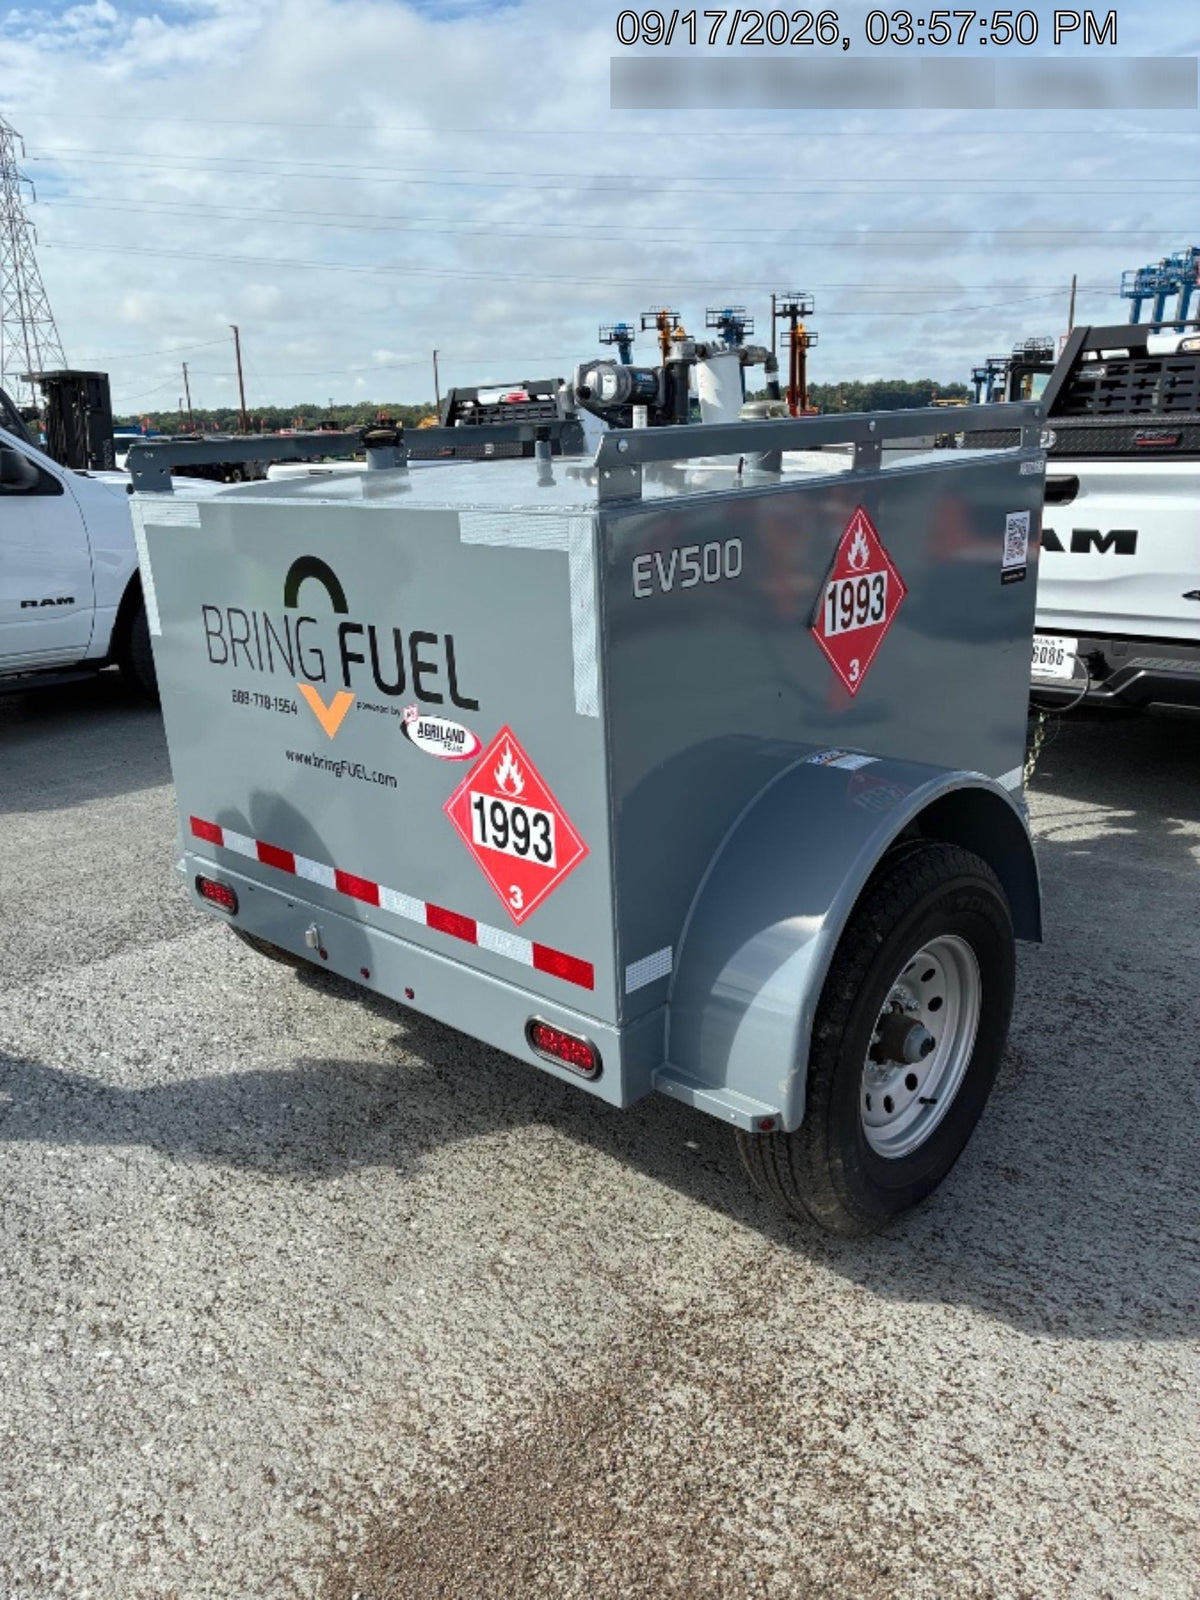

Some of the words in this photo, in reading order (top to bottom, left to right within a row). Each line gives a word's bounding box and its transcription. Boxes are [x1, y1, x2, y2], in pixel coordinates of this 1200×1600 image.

[1040, 528, 1138, 555] AM
[632, 537, 742, 599] EV500
[20, 597, 75, 608] RAM
[827, 574, 885, 632] 1993
[202, 604, 326, 683] BRING
[338, 622, 480, 711] FUEL
[848, 658, 860, 682] 3
[417, 721, 465, 744] AGRILAND
[285, 750, 397, 789] www.bringFUEL.com
[473, 795, 553, 863] 1993
[509, 885, 524, 910] 3
